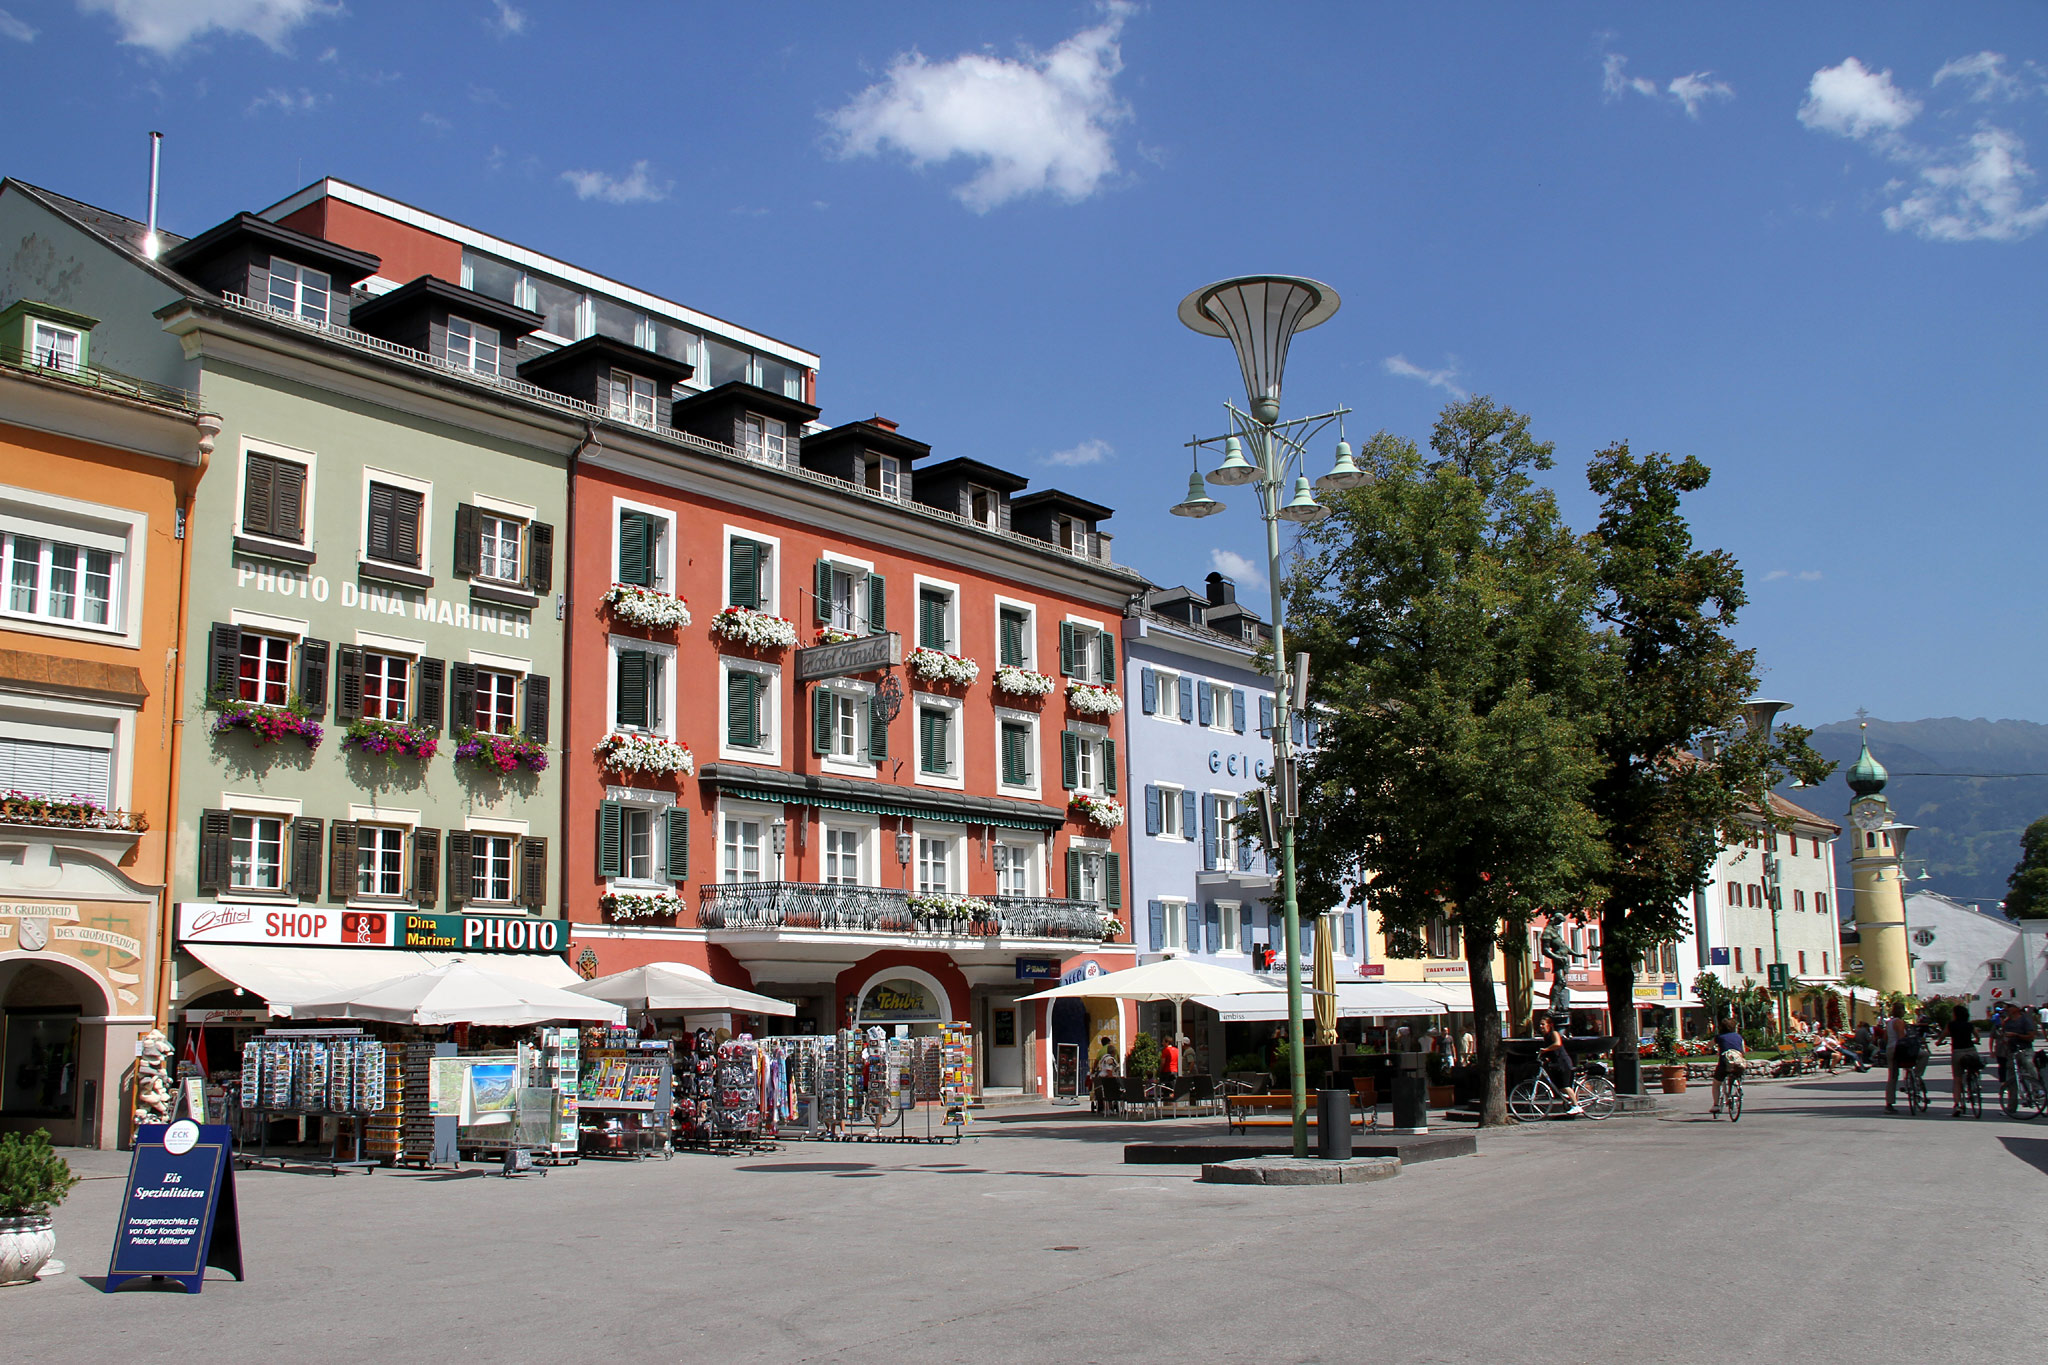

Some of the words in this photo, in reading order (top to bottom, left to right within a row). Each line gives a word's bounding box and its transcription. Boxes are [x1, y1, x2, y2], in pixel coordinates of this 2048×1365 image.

[237, 561, 330, 603] PHOTO
[341, 581, 407, 617] DINA
[415, 595, 531, 640] MARINER
[803, 648, 837, 674] Hotel
[191, 906, 252, 931] Osttirol
[265, 912, 328, 938] SHOP
[407, 916, 437, 930] Dina
[57, 928, 75, 938] DES
[357, 932, 371, 944] KG
[464, 918, 558, 950] PHOTO
[407, 933, 457, 947] Mariner
[1097, 1019, 1118, 1031] BAR
[1097, 1033, 1118, 1044] CFÉ
[172, 1130, 189, 1139] ECK
[162, 1172, 182, 1183] Eis
[134, 1186, 206, 1200] Spezialitäten
[129, 1217, 188, 1227] hausgemachtes
[188, 1217, 200, 1226] Eis
[129, 1227, 143, 1235] von
[144, 1227, 158, 1236] der
